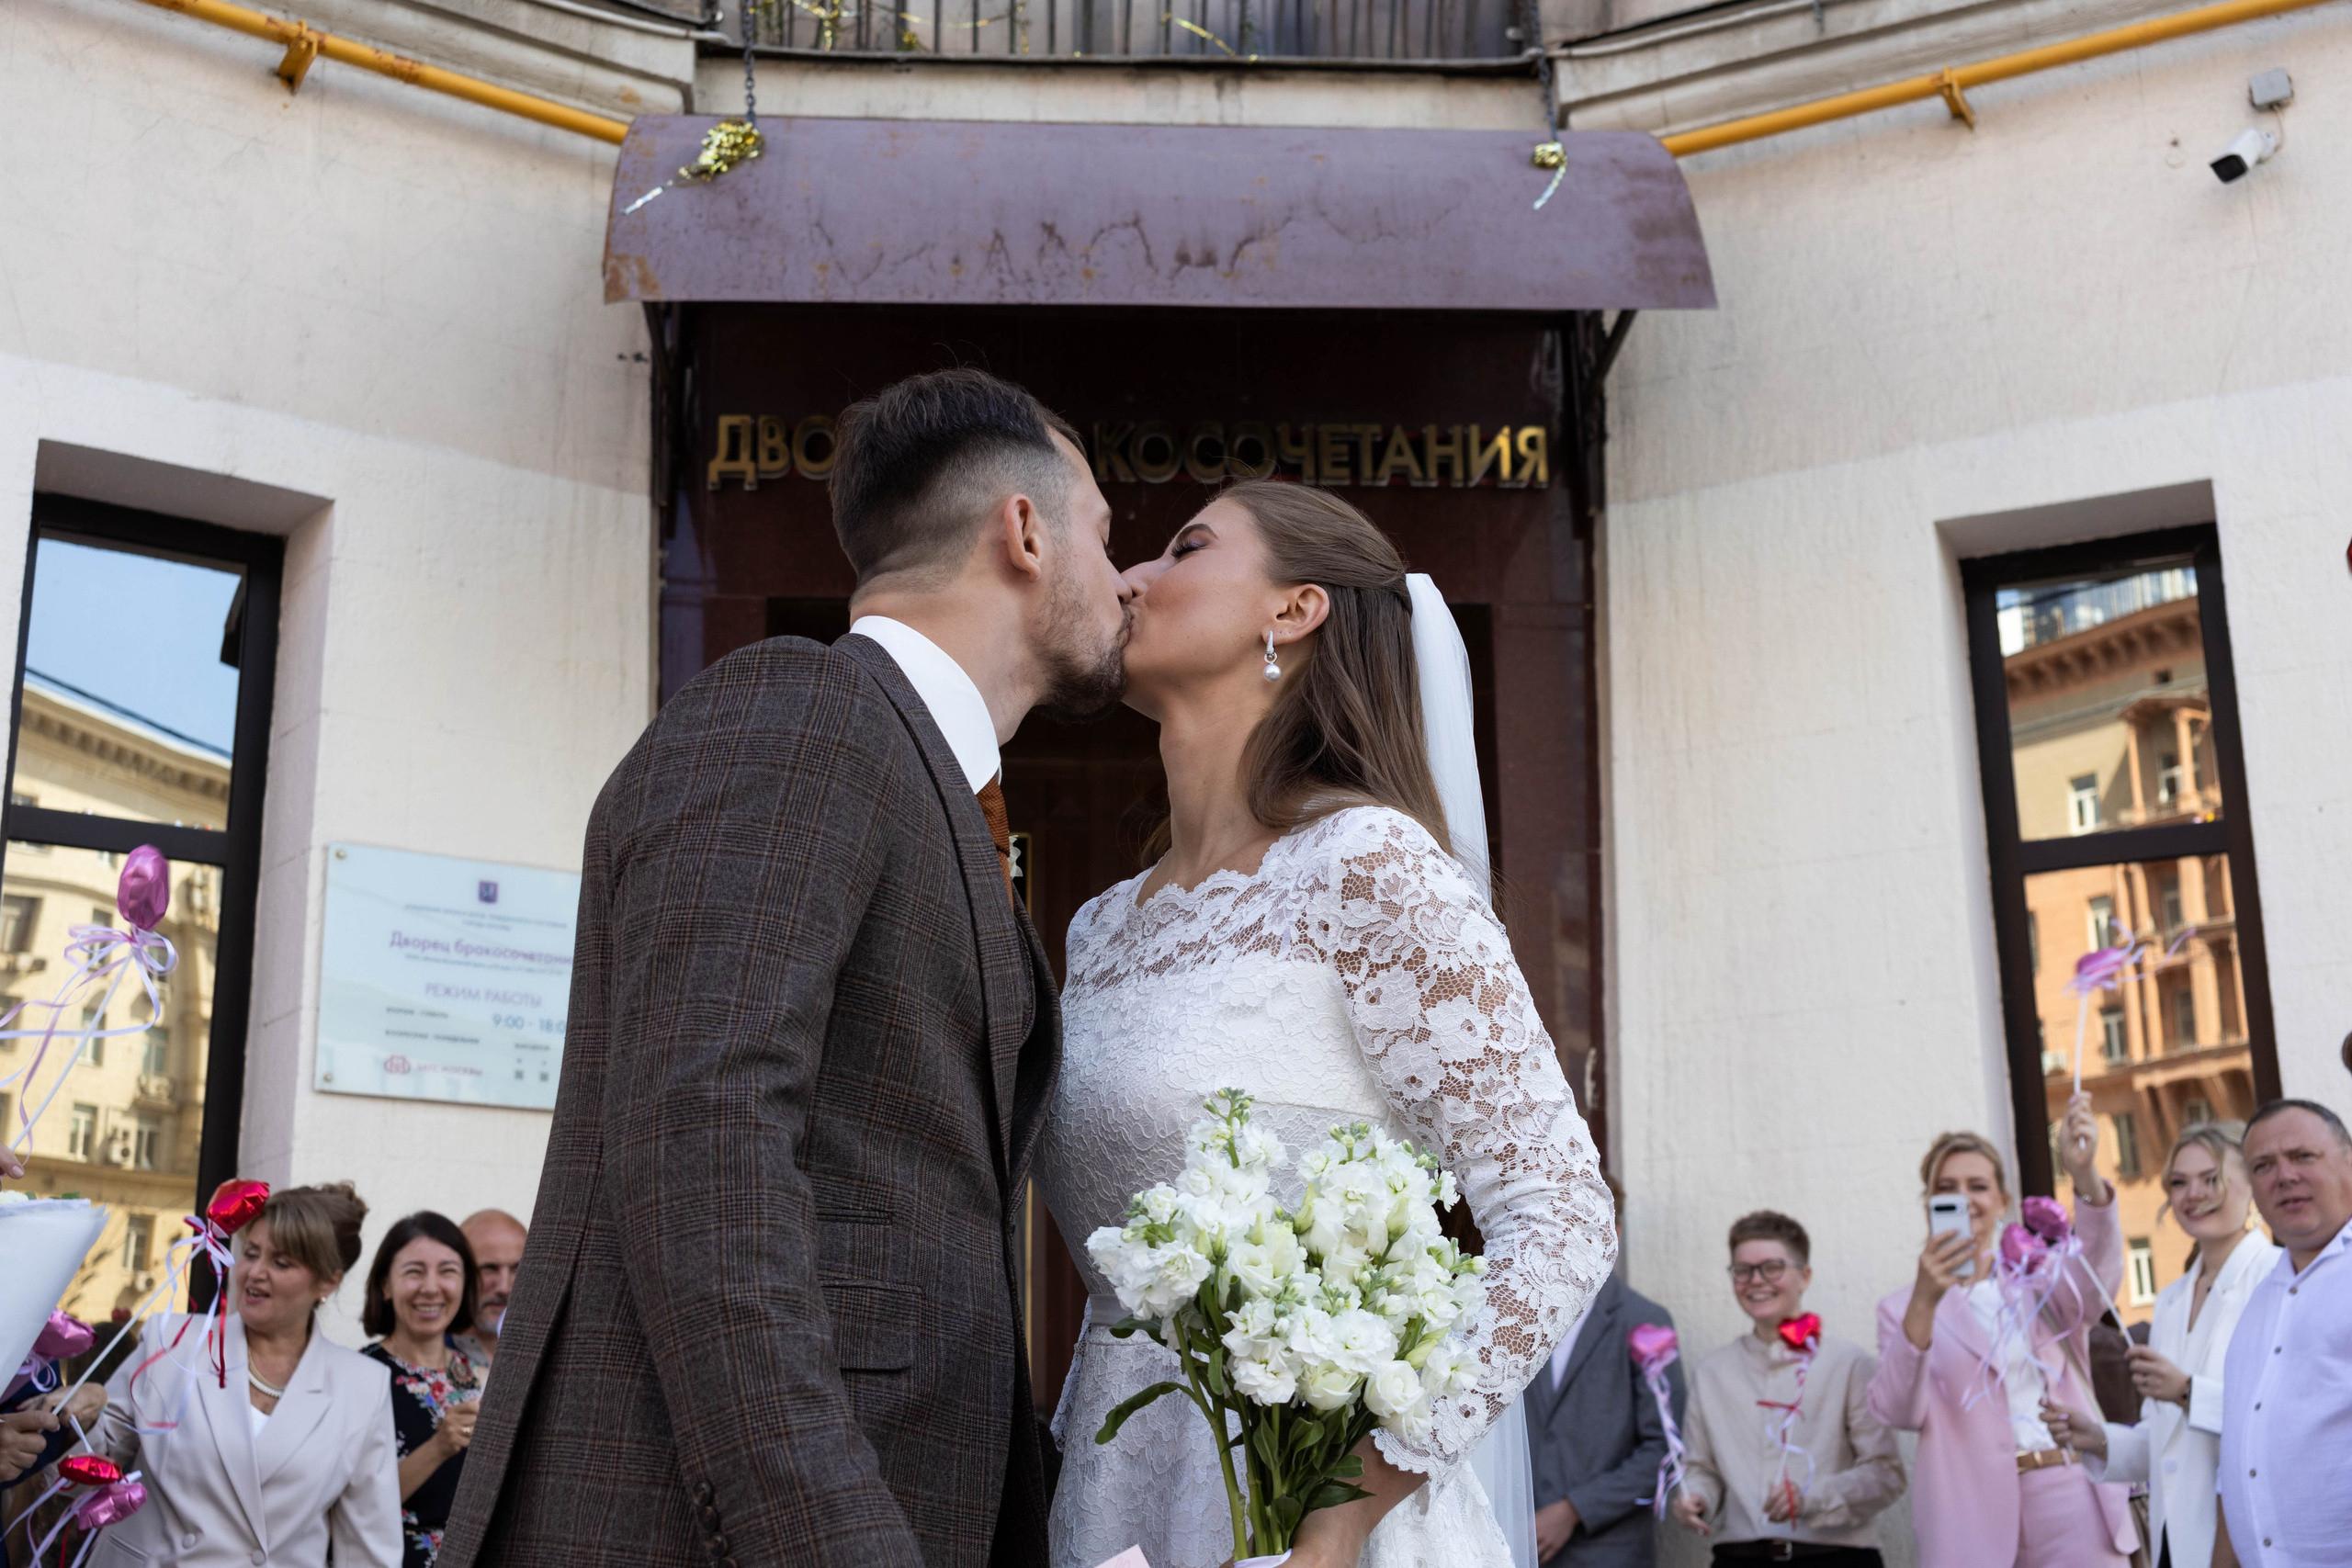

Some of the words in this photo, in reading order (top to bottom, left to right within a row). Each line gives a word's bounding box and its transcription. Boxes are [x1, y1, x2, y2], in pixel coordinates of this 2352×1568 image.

[707, 413, 835, 491] ДВО
[1092, 419, 1549, 489] КОСОЧЕТАНИЯ
[390, 931, 450, 953] Дворец
[454, 938, 574, 964] бракосочетани
[425, 983, 480, 1001] РЕЖИМ
[485, 989, 542, 1008] РАБОТЫ
